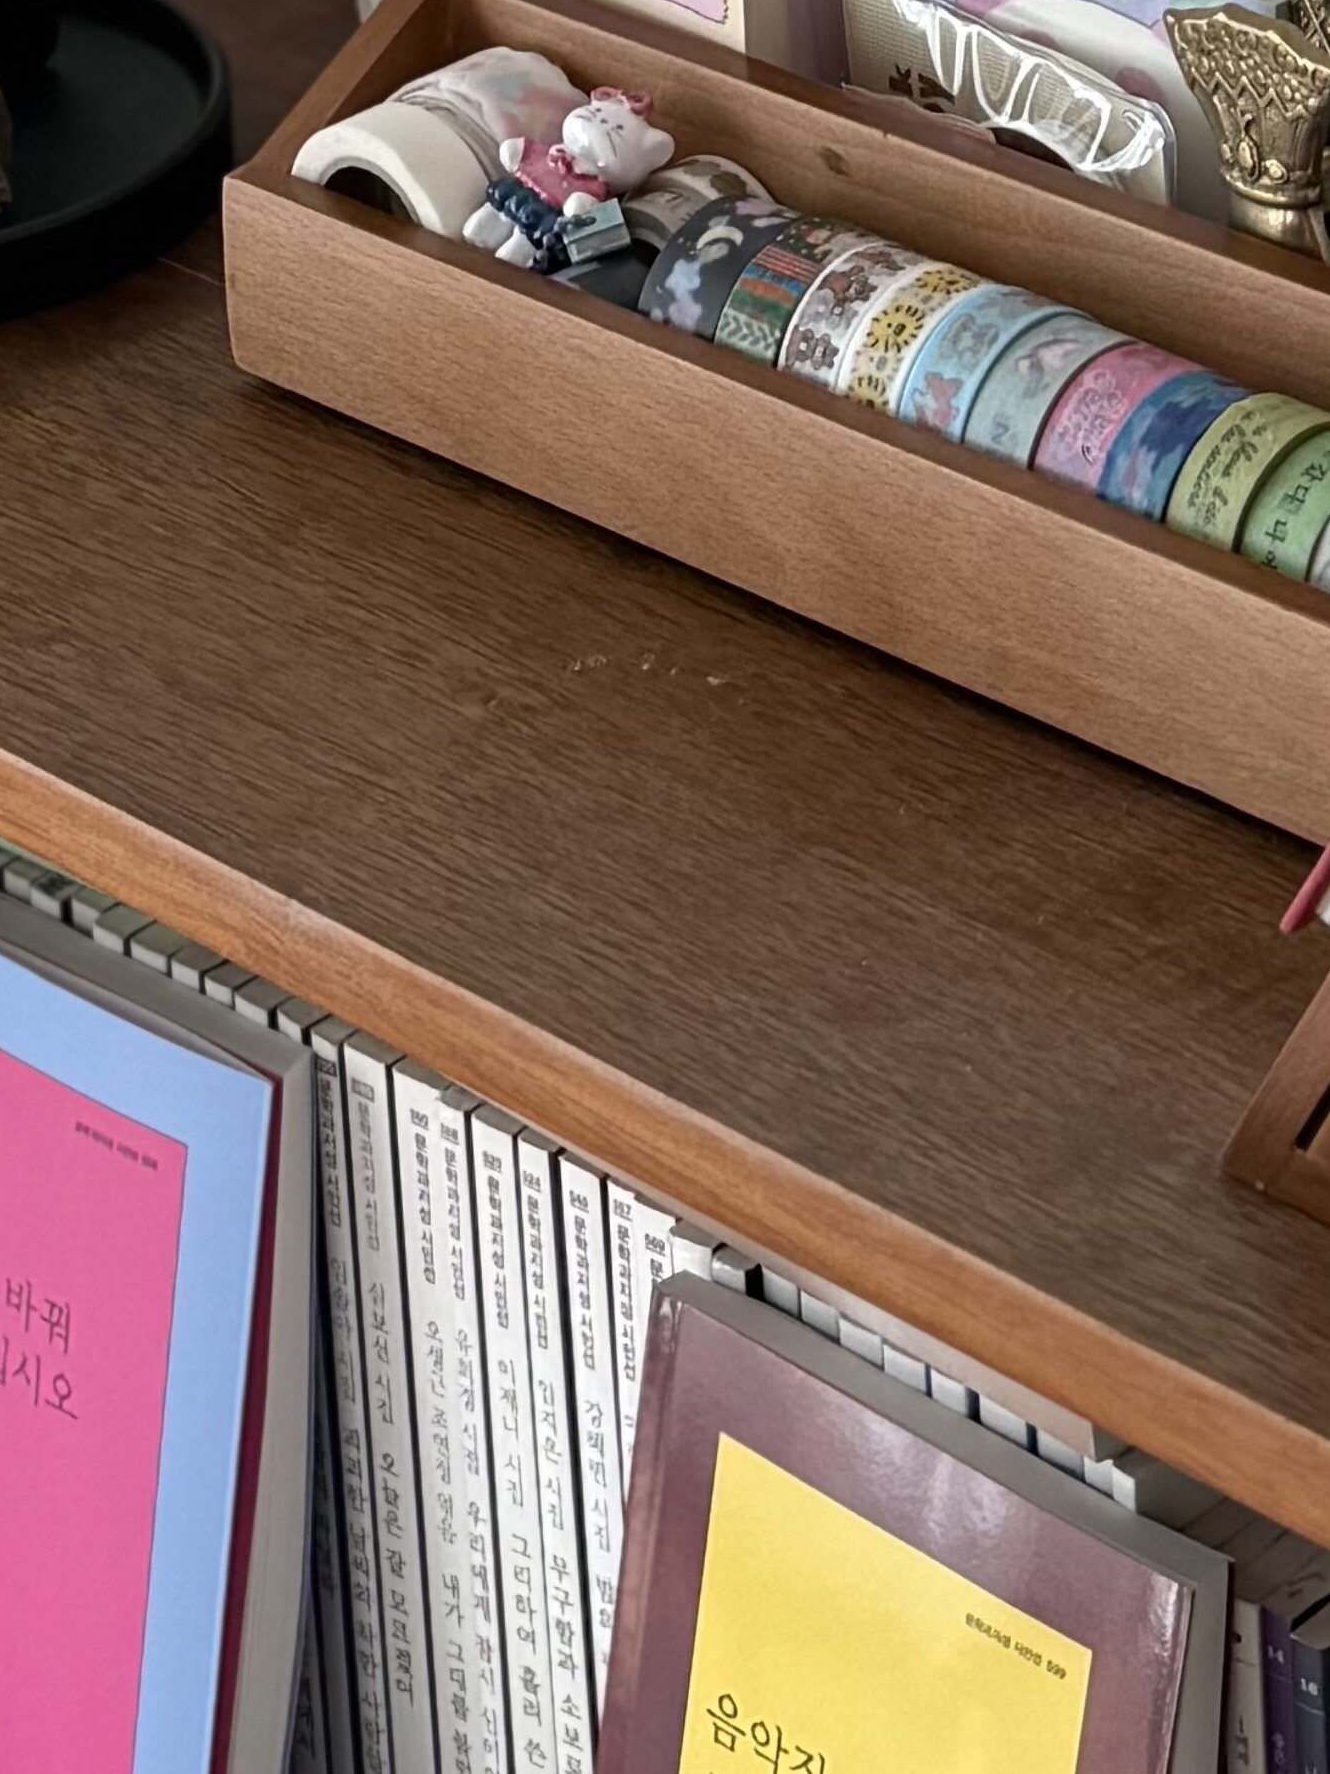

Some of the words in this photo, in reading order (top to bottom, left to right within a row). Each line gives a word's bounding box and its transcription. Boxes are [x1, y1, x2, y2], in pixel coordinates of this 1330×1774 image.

[487, 1175, 506, 1271] 문학과지성
[573, 1214, 592, 1311] 문학과지성
[616, 1223, 635, 1323] 문학과지성
[4, 1276, 72, 1356] 바꿔
[497, 1358, 519, 1441] 이제니
[526, 1194, 545, 1290] 문학과지성
[545, 1475, 565, 1532] 시집
[503, 1453, 524, 1508] 시집
[441, 1572, 466, 1629] 내가
[510, 1531, 538, 1657] 그리하여
[479, 1705, 500, 1774] 신이
[522, 1736, 548, 1769] 쓴
